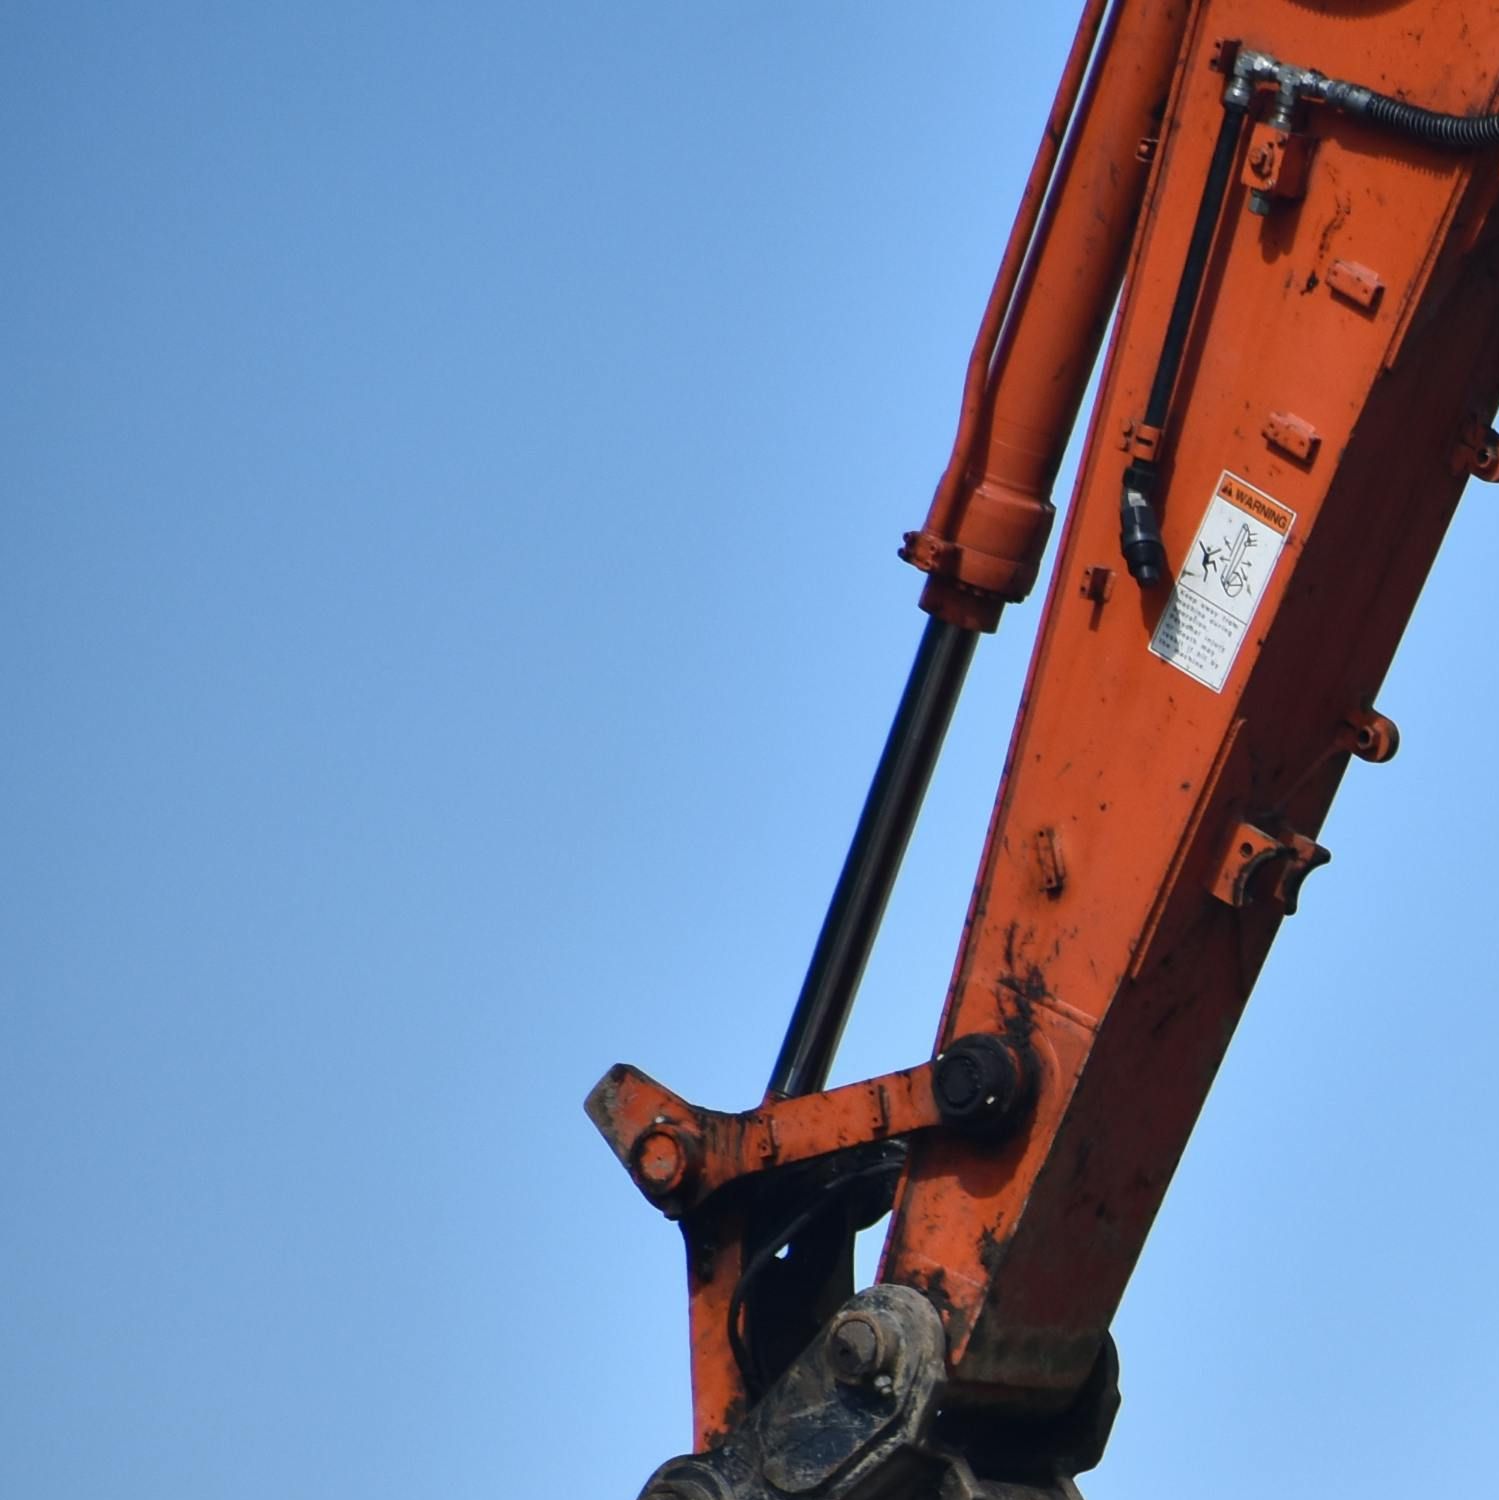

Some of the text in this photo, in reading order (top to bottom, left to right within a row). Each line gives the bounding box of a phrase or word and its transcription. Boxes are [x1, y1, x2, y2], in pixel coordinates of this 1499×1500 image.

[1233, 488, 1288, 530] WARNING
[1174, 596, 1233, 637] machine during
[1178, 589, 1240, 630] Keep away from
[1199, 643, 1215, 657] may
